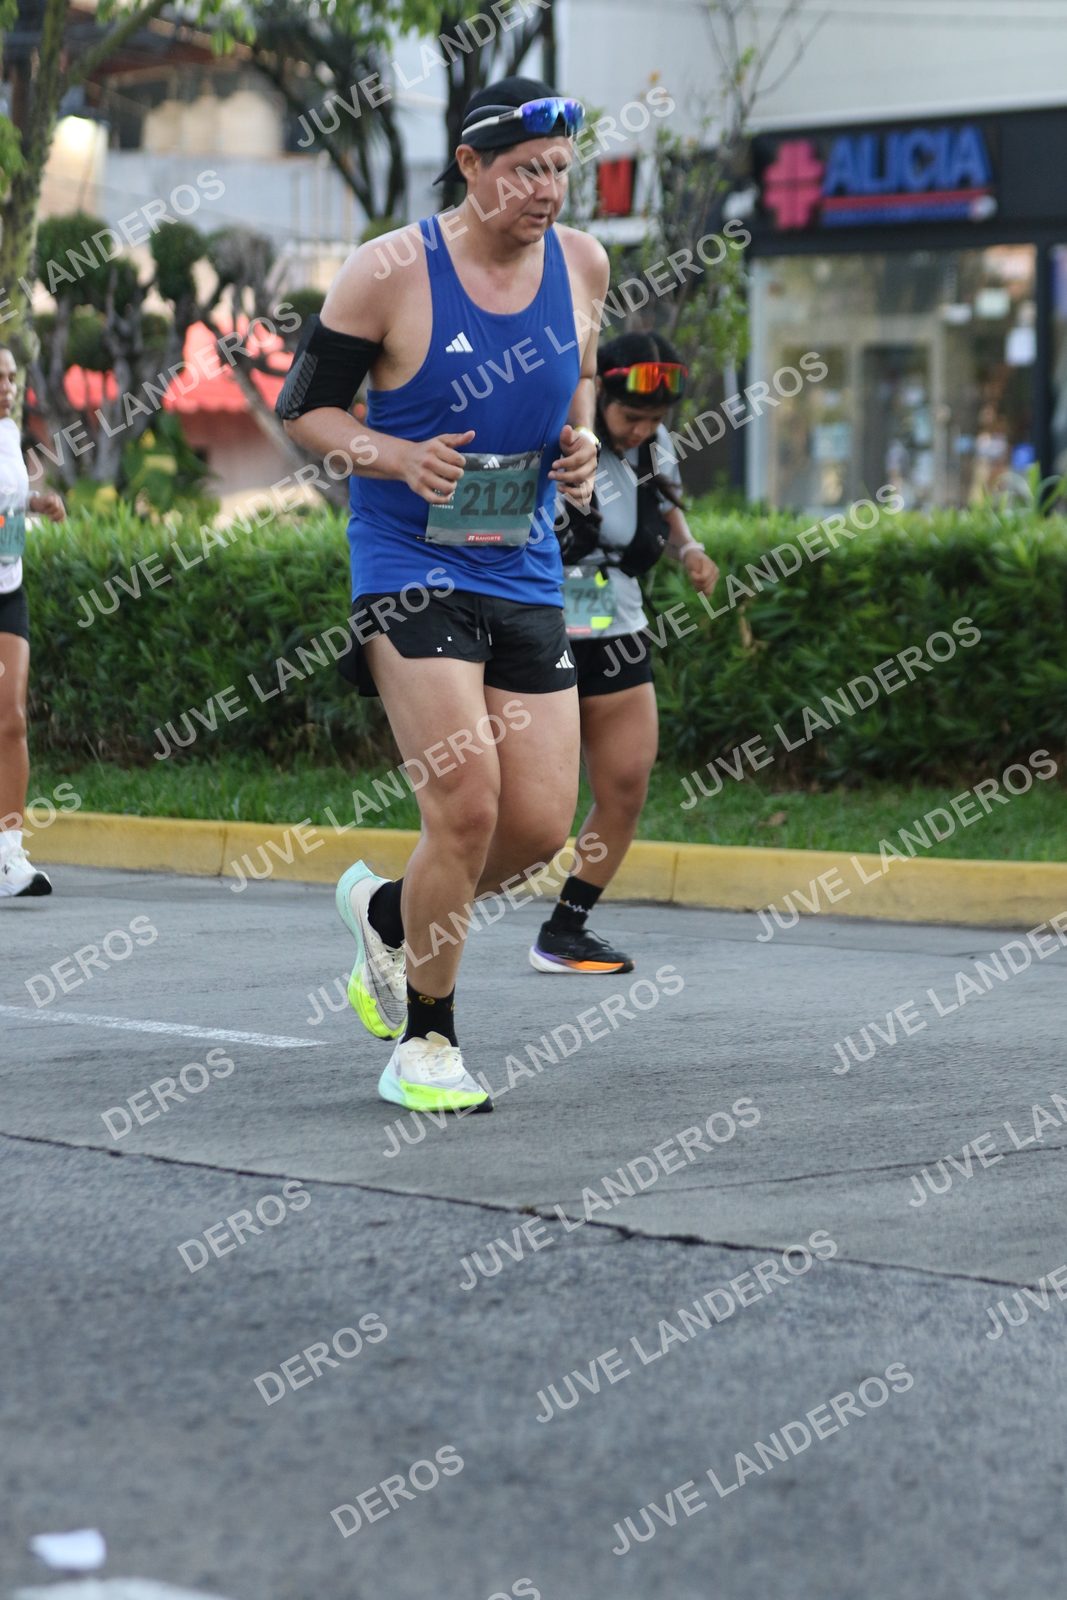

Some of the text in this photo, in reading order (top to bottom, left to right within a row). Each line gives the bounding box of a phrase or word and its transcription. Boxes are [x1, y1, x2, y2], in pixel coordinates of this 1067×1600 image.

[822, 126, 993, 195] ALICIA
[460, 480, 535, 516] 2122
[561, 587, 618, 614] 726
